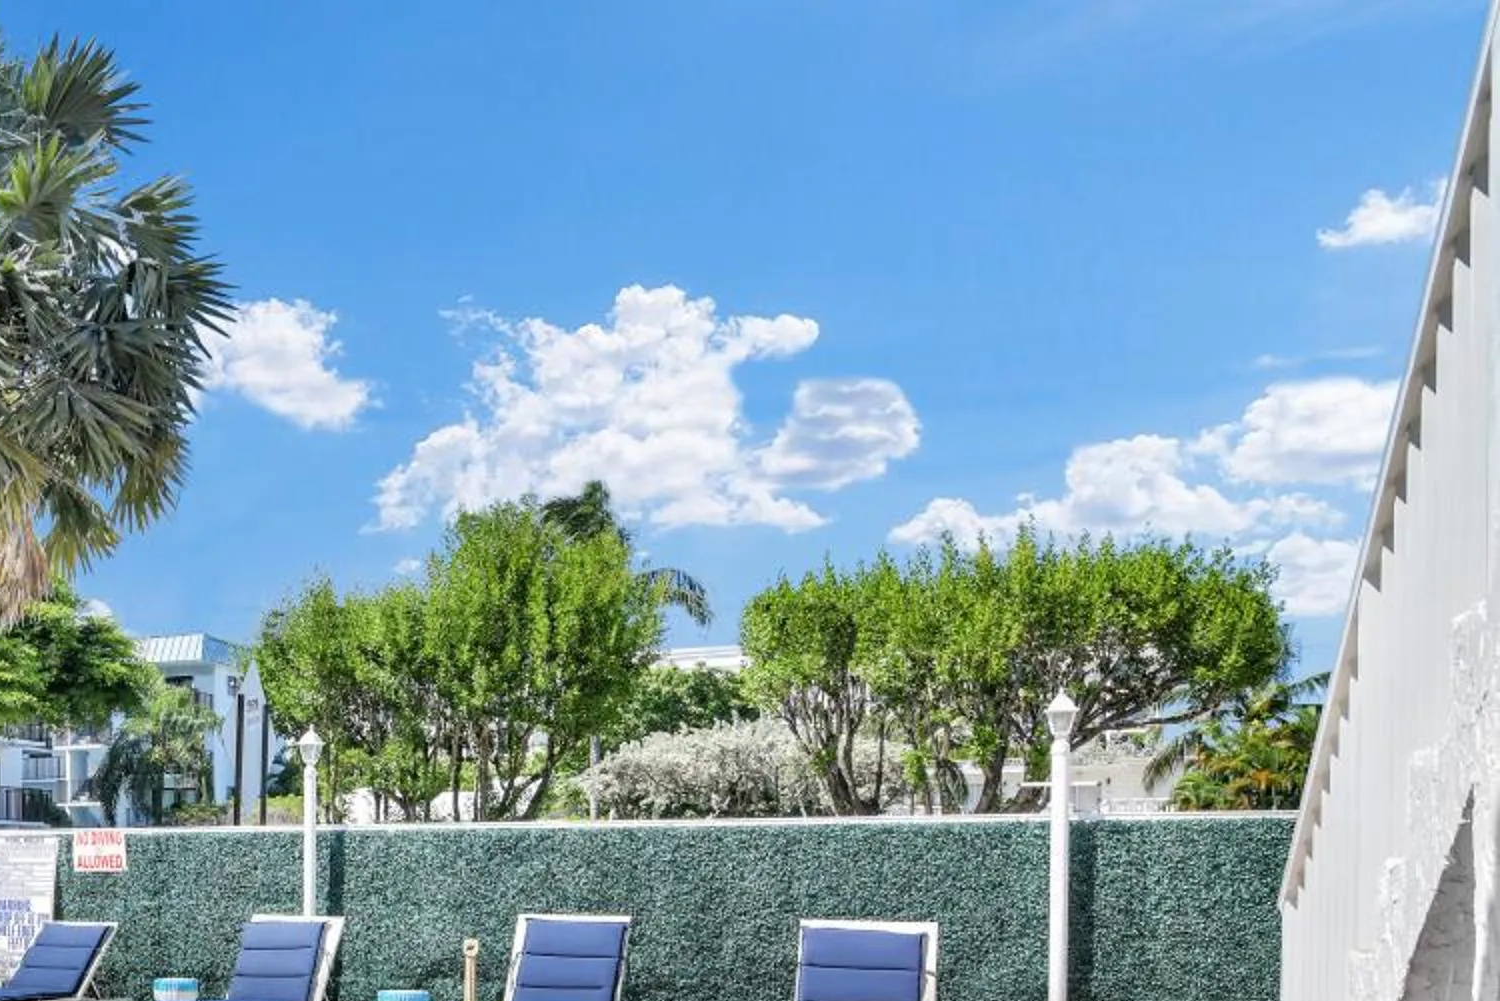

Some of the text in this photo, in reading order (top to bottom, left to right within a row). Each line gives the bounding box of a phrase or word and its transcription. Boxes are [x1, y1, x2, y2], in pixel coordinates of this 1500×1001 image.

[75, 830, 123, 846] NO DIVING
[76, 854, 123, 869] ALLOWED
